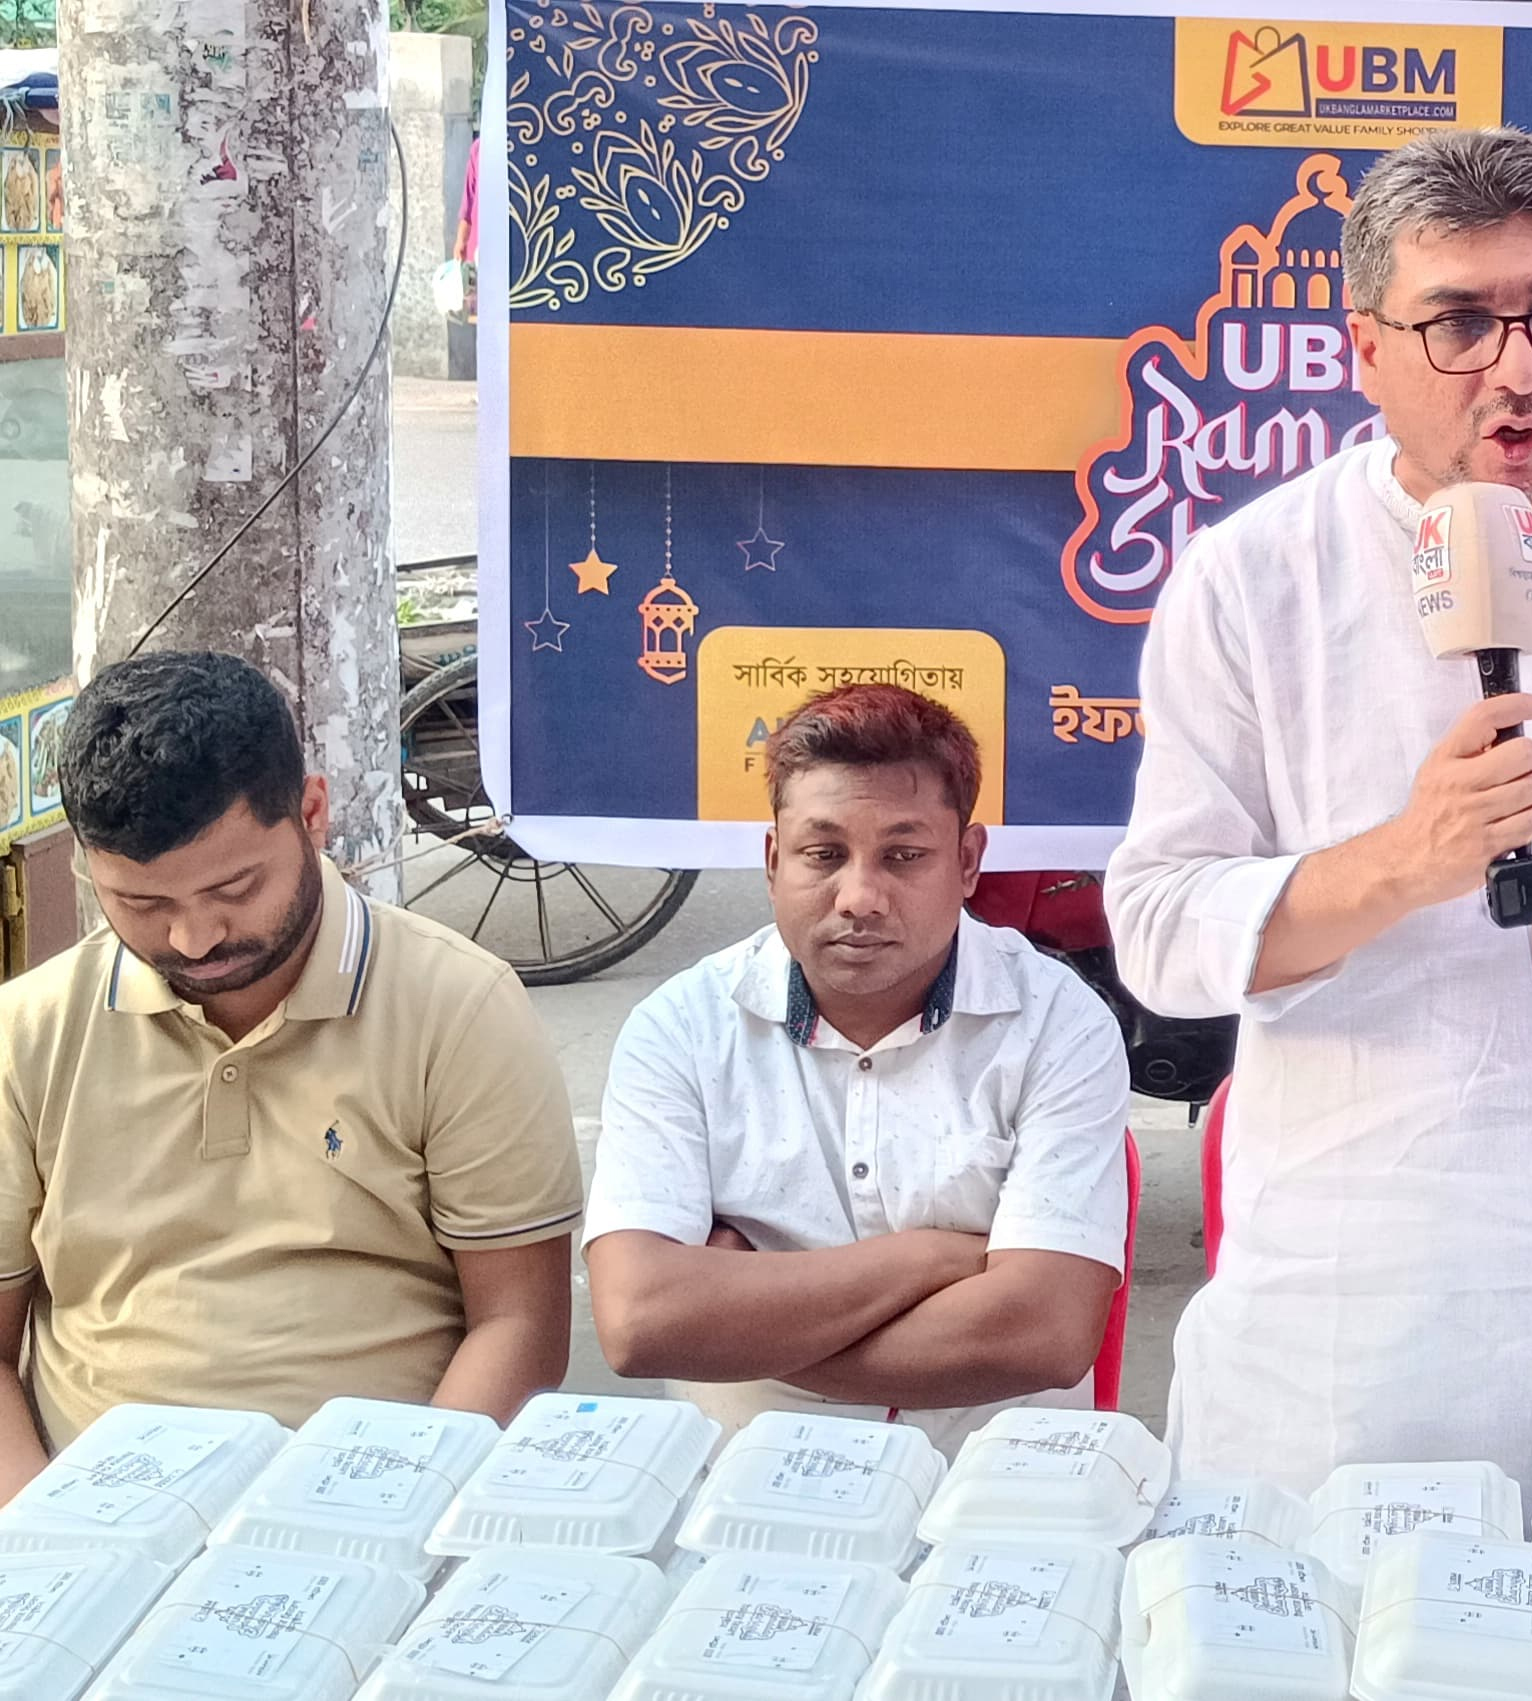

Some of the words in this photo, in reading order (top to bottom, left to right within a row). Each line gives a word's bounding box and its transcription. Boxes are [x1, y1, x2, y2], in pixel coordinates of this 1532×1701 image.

[1316, 45, 1456, 95] UBM
[1218, 121, 1271, 132] EXPLORE
[1274, 122, 1312, 133] GREAT
[1314, 123, 1351, 134] VALUE
[1353, 124, 1393, 136] FAMILY
[1223, 323, 1363, 391] UB
[733, 655, 807, 690] সার্বিক
[816, 659, 964, 692] সহযোগিতায়
